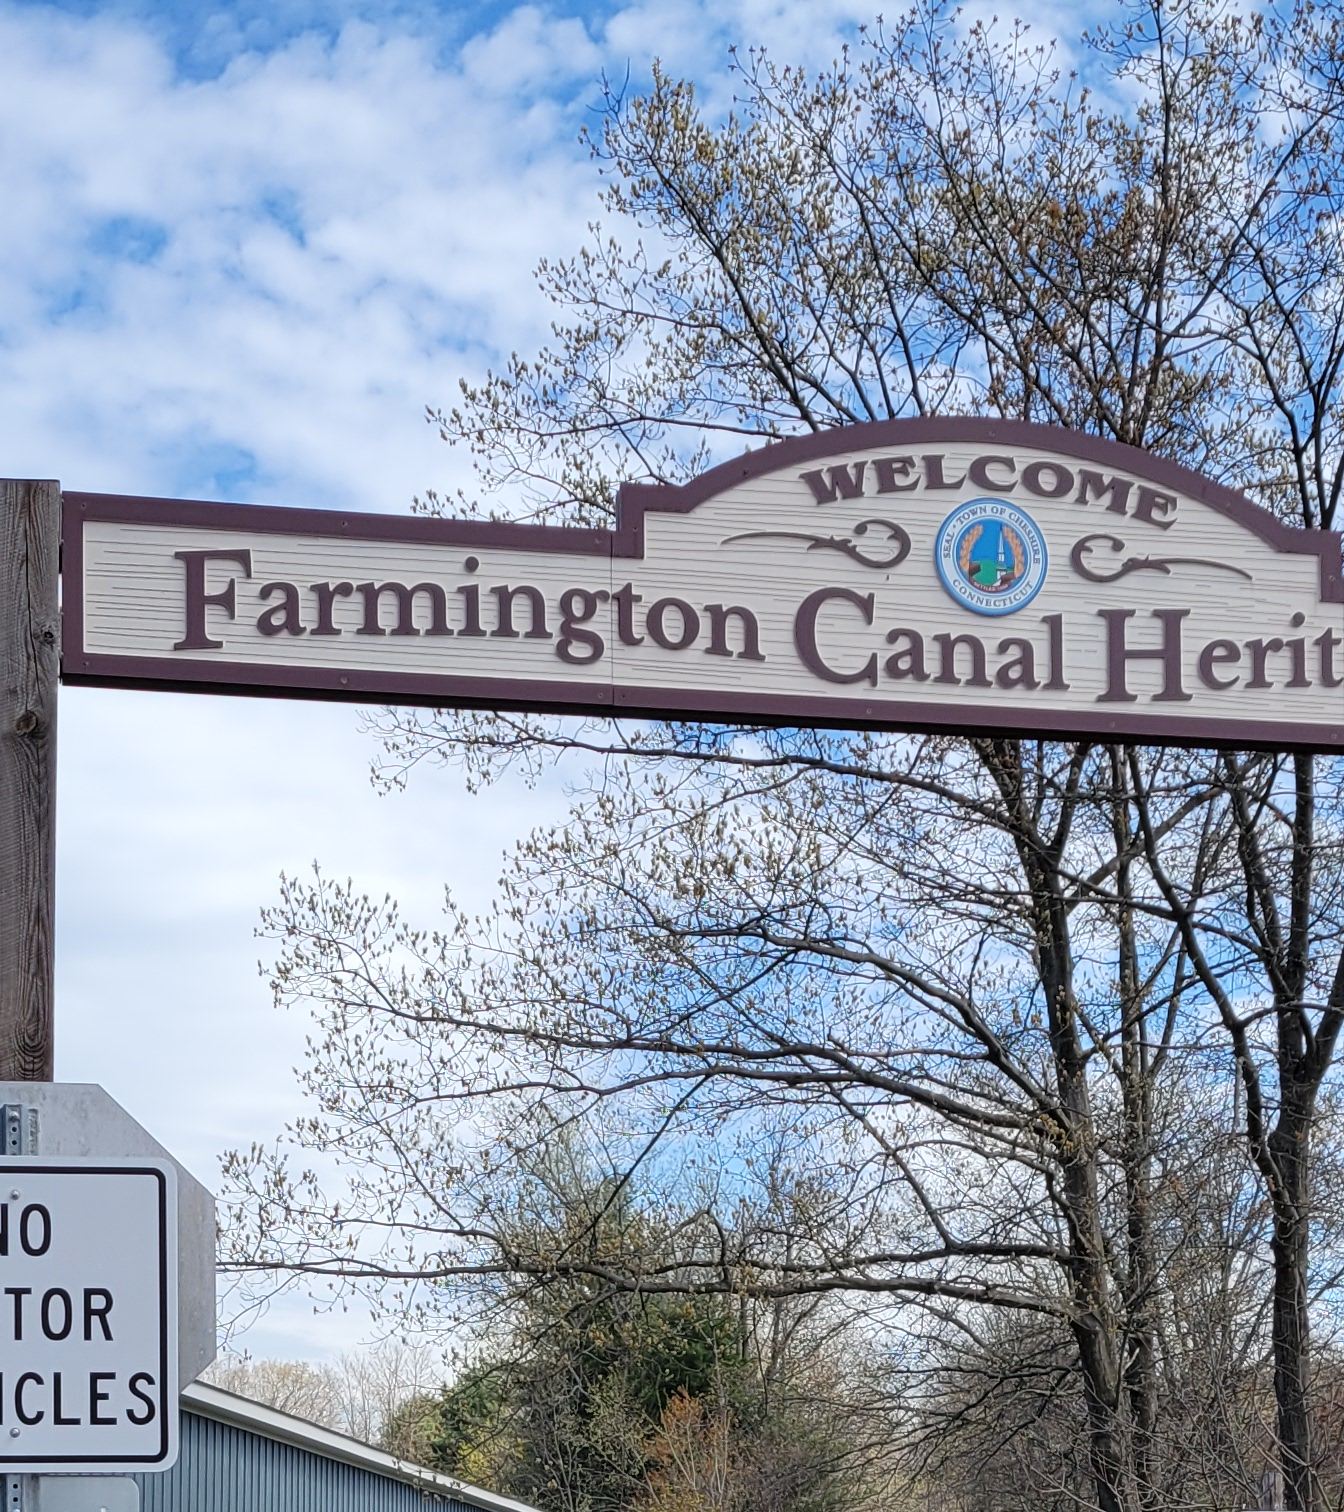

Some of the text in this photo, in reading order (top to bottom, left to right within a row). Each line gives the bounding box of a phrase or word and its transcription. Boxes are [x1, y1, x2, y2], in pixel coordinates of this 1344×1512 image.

[800, 453, 1179, 530] WELCOME
[943, 505, 1041, 565] SEAL TOWN OF CHESHIRE
[173, 548, 767, 665] Farmington
[794, 586, 1071, 691] Canal
[952, 578, 1034, 608] CONNECTICUT
